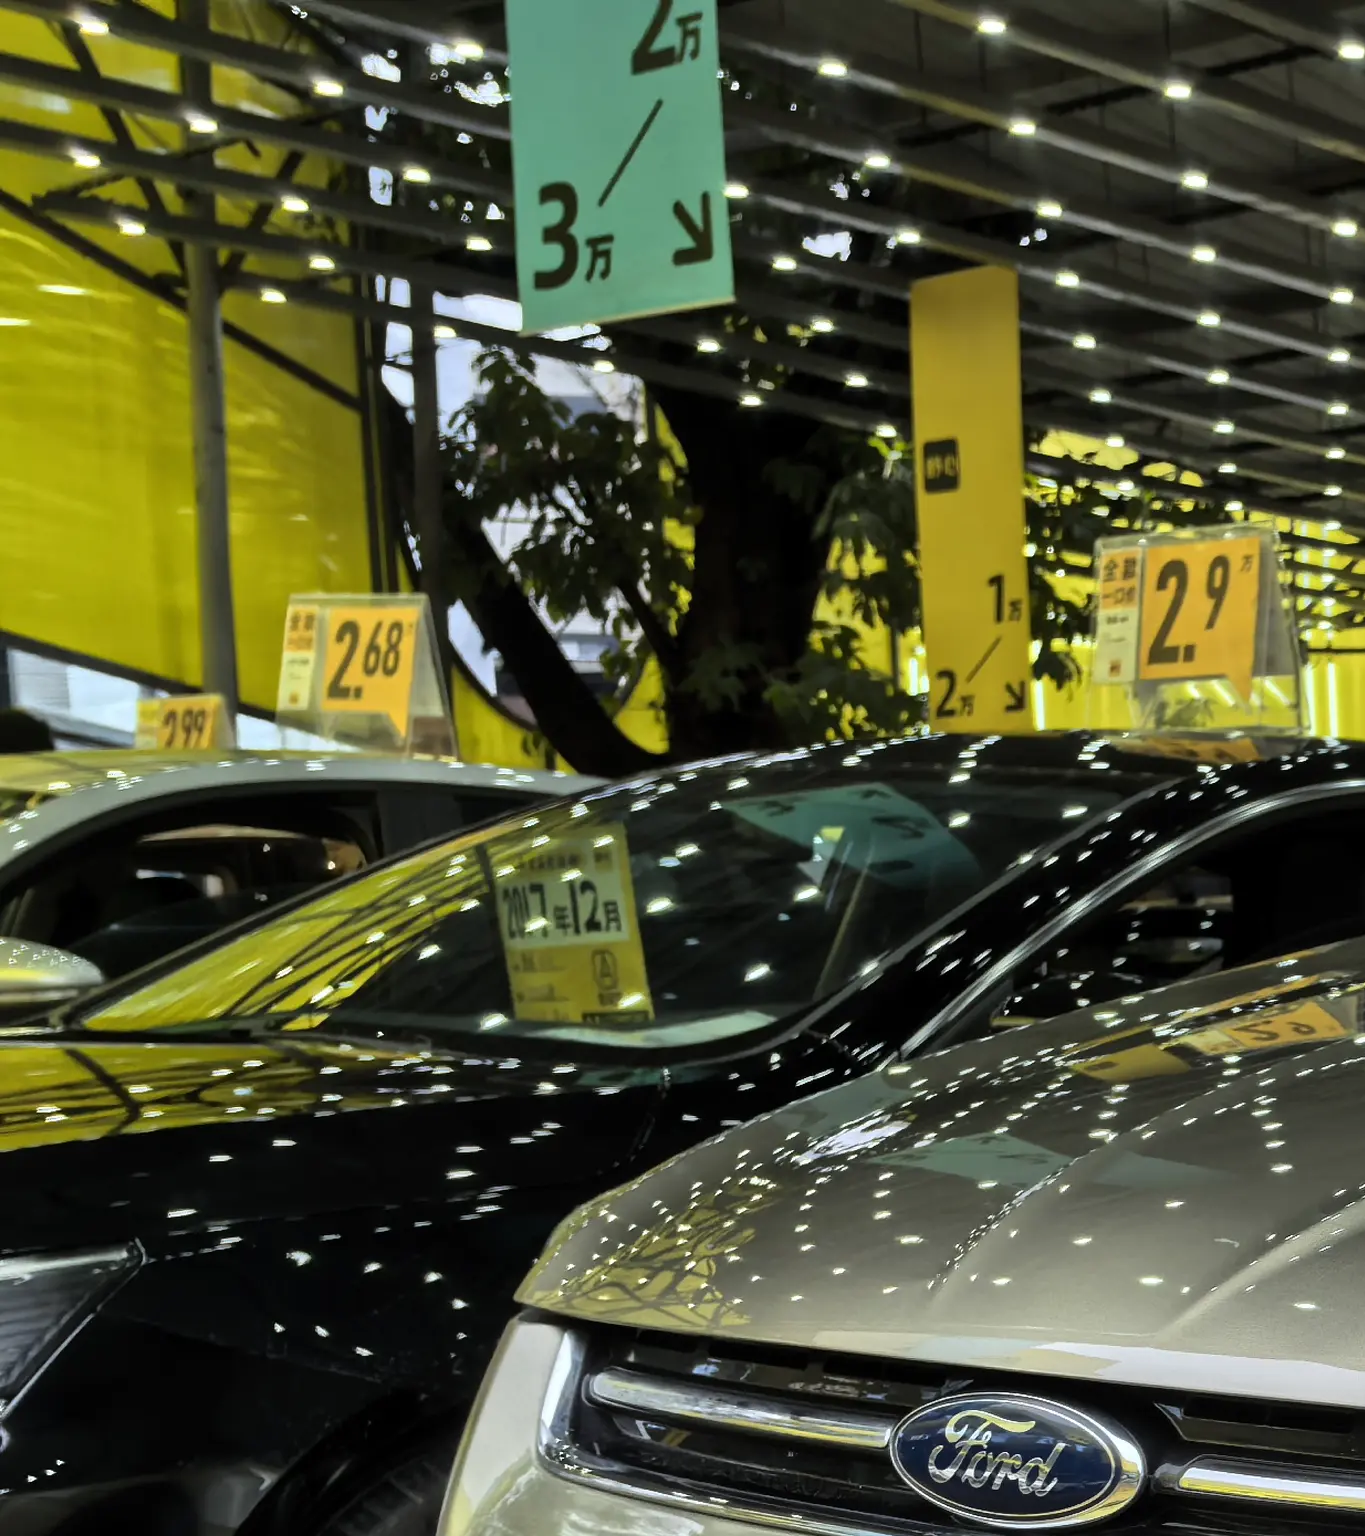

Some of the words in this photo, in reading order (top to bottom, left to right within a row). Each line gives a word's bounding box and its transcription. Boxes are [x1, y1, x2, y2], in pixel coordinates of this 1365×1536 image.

[533, 180, 615, 291] 3万
[987, 573, 1023, 624] 1万
[935, 669, 975, 719] 2万
[928, 1409, 1067, 1497] Ford
